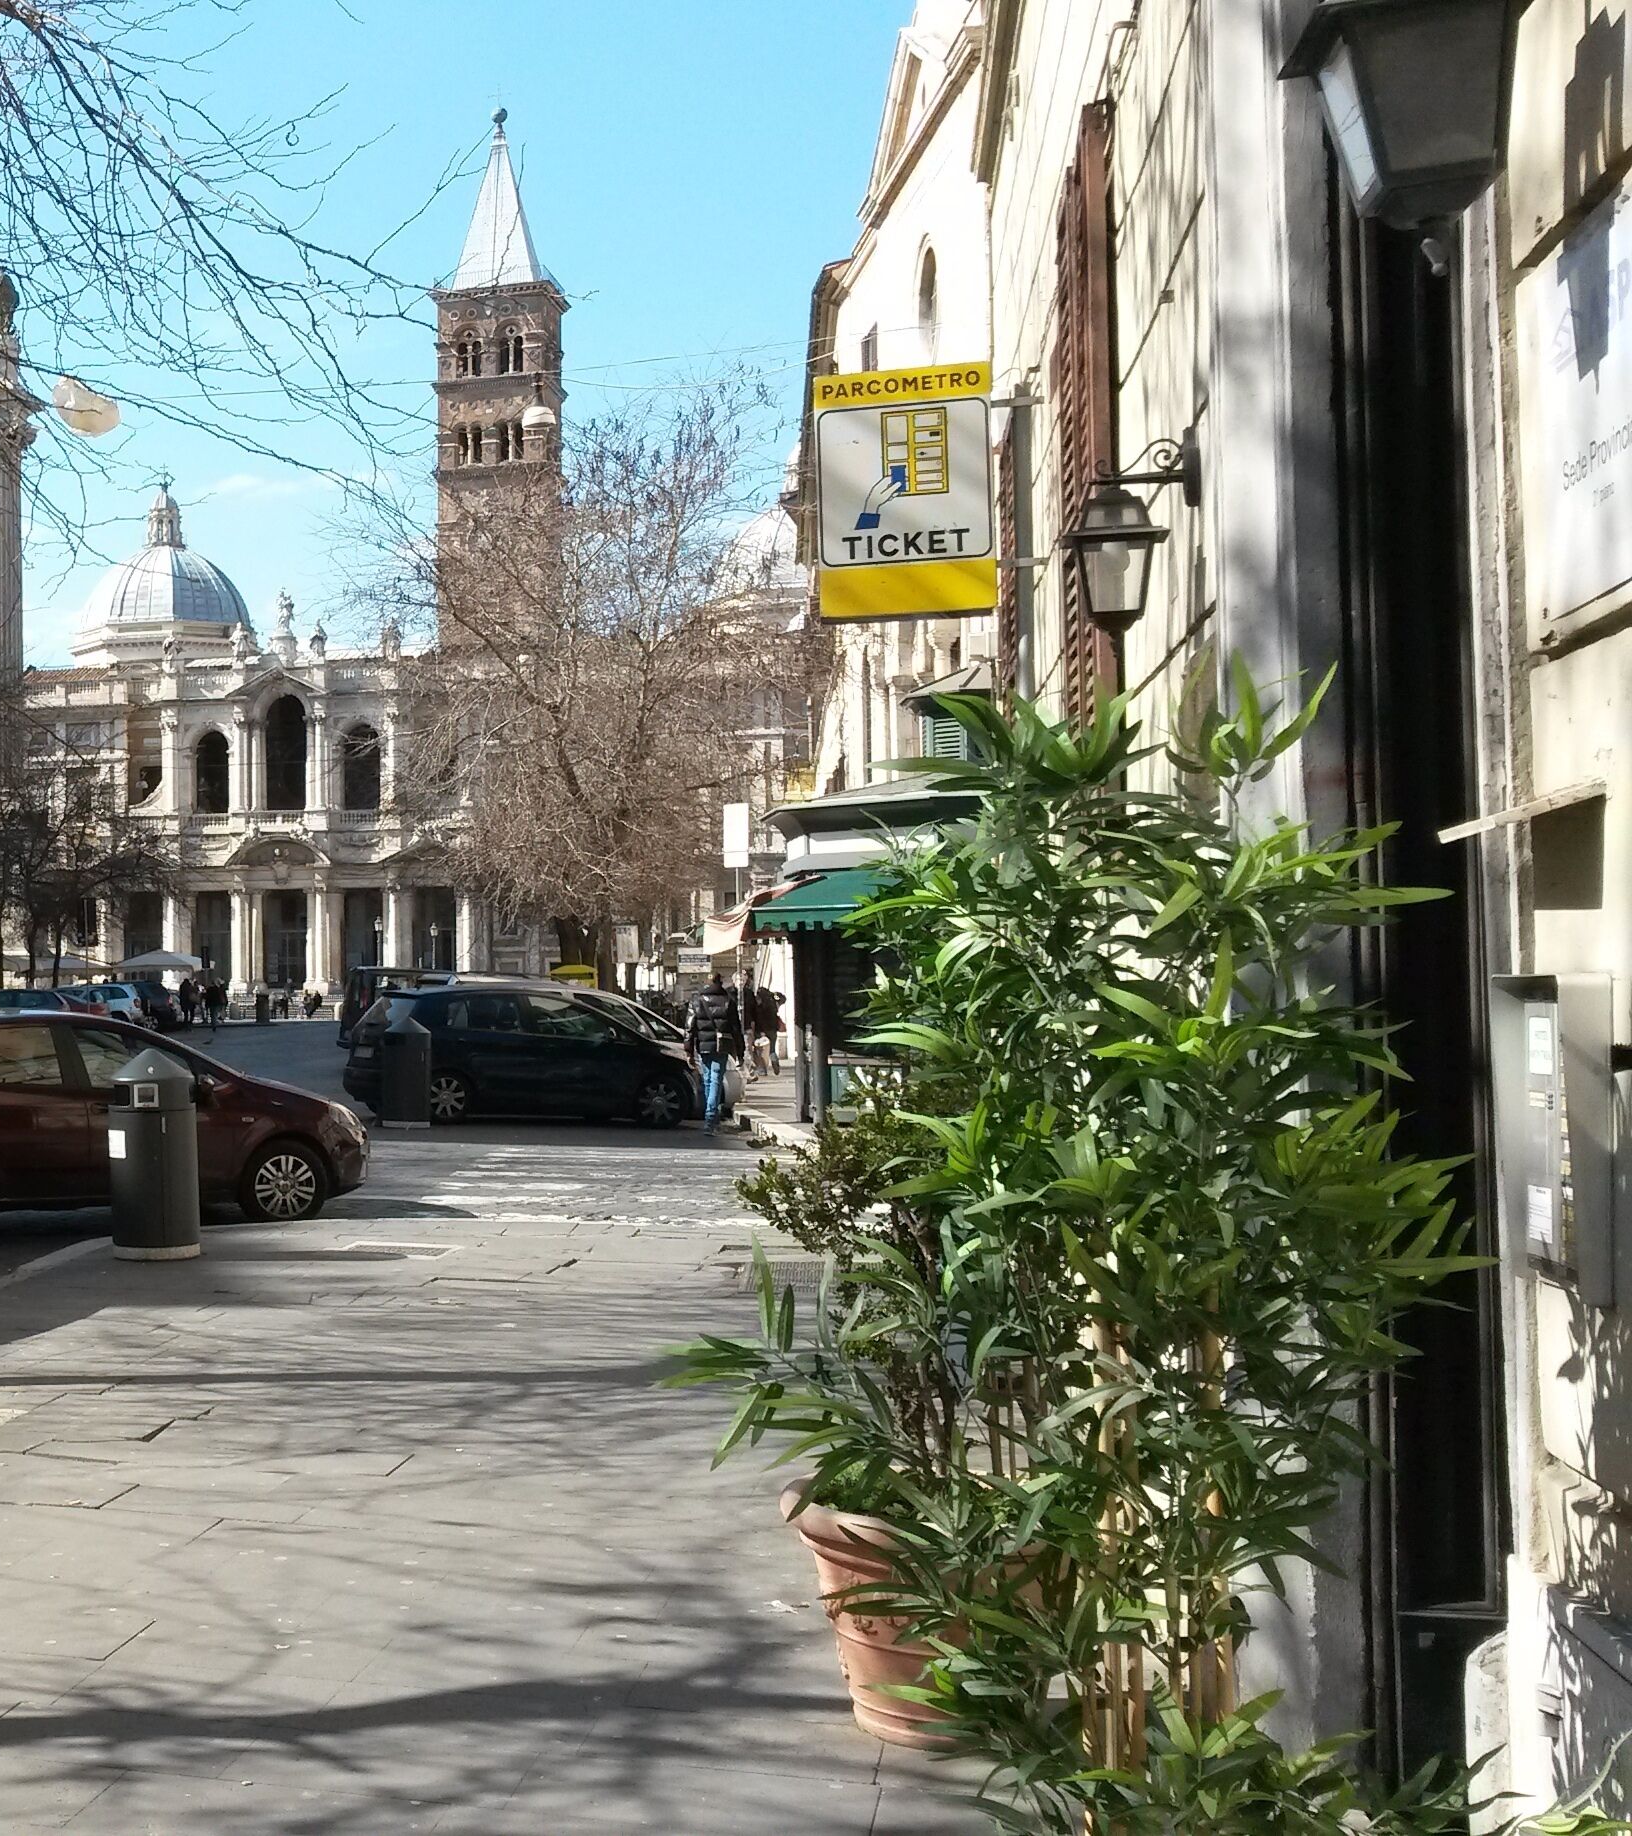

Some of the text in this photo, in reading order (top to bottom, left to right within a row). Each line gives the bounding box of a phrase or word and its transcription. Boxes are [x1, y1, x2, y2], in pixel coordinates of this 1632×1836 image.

[821, 369, 981, 401] PARCOMETRO
[1563, 414, 1632, 492] Sede Provinci
[842, 527, 971, 561] TICKET
